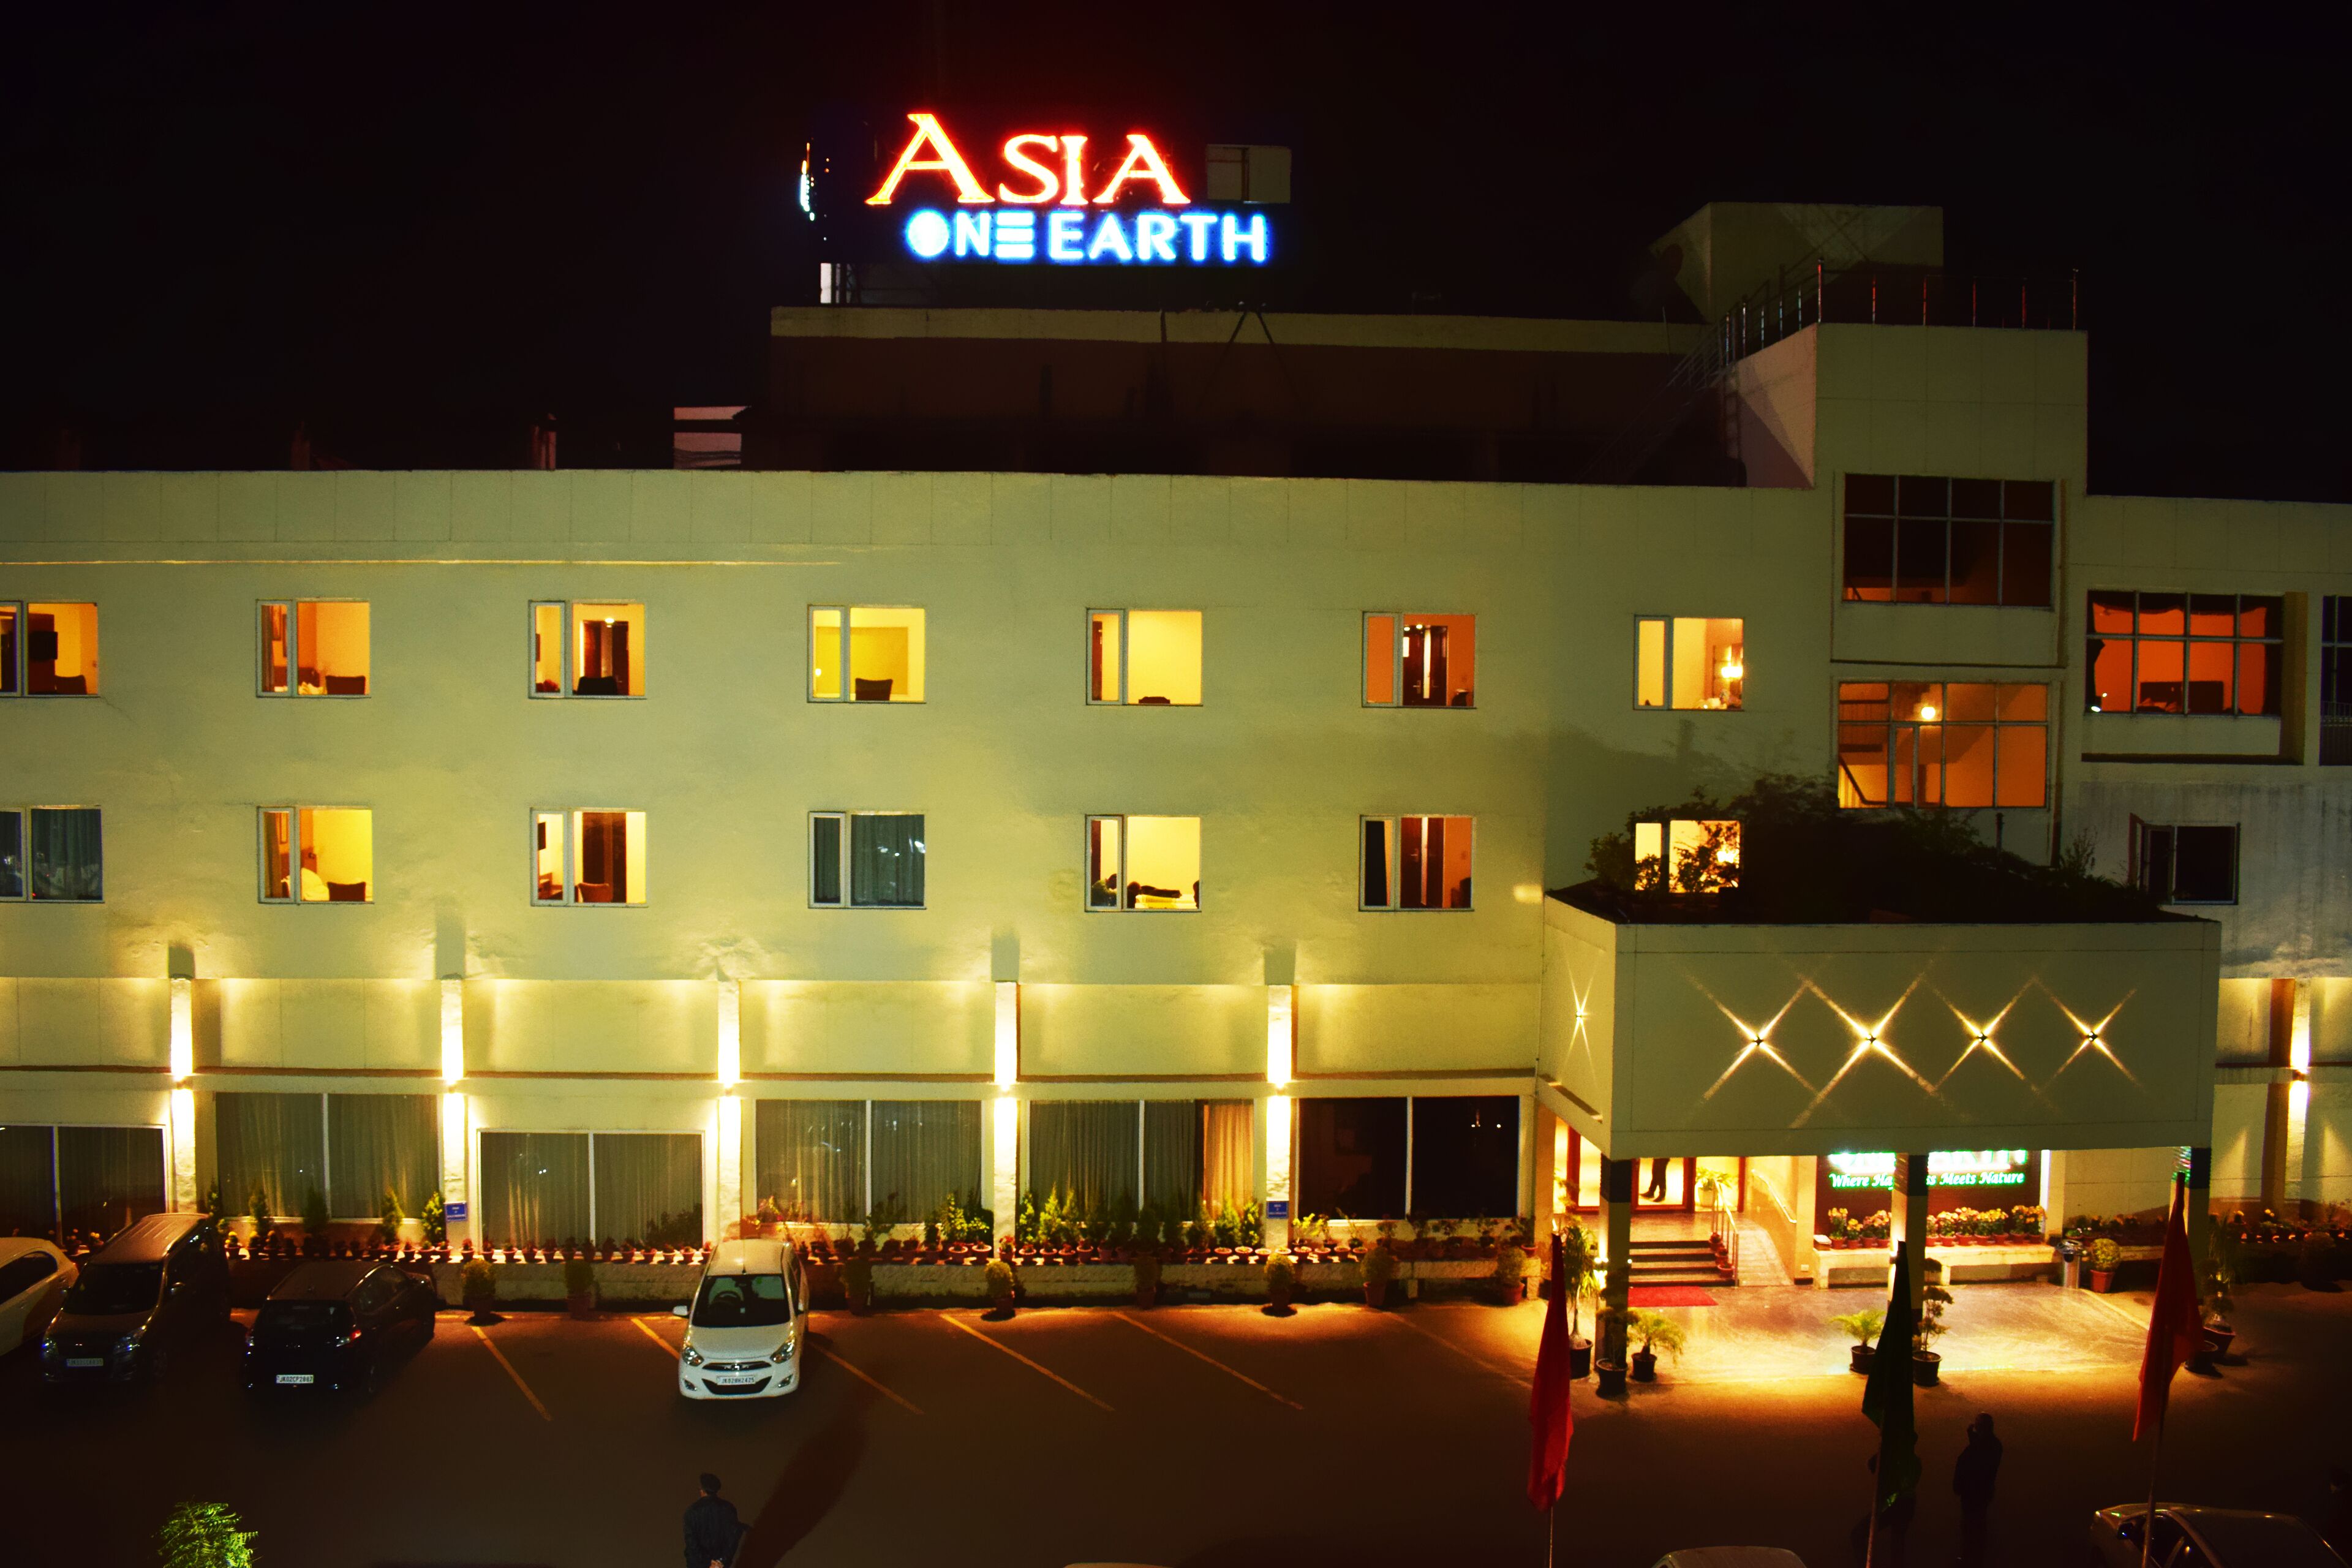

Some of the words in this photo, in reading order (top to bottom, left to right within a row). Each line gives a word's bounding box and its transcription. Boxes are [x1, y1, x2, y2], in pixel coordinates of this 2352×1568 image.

[864, 113, 1192, 206] ASIA
[1047, 211, 1268, 262] EARTH
[1828, 1172, 1871, 1188] Where
[1939, 1172, 1977, 1186] Meets
[1978, 1170, 2025, 1185] Nature
